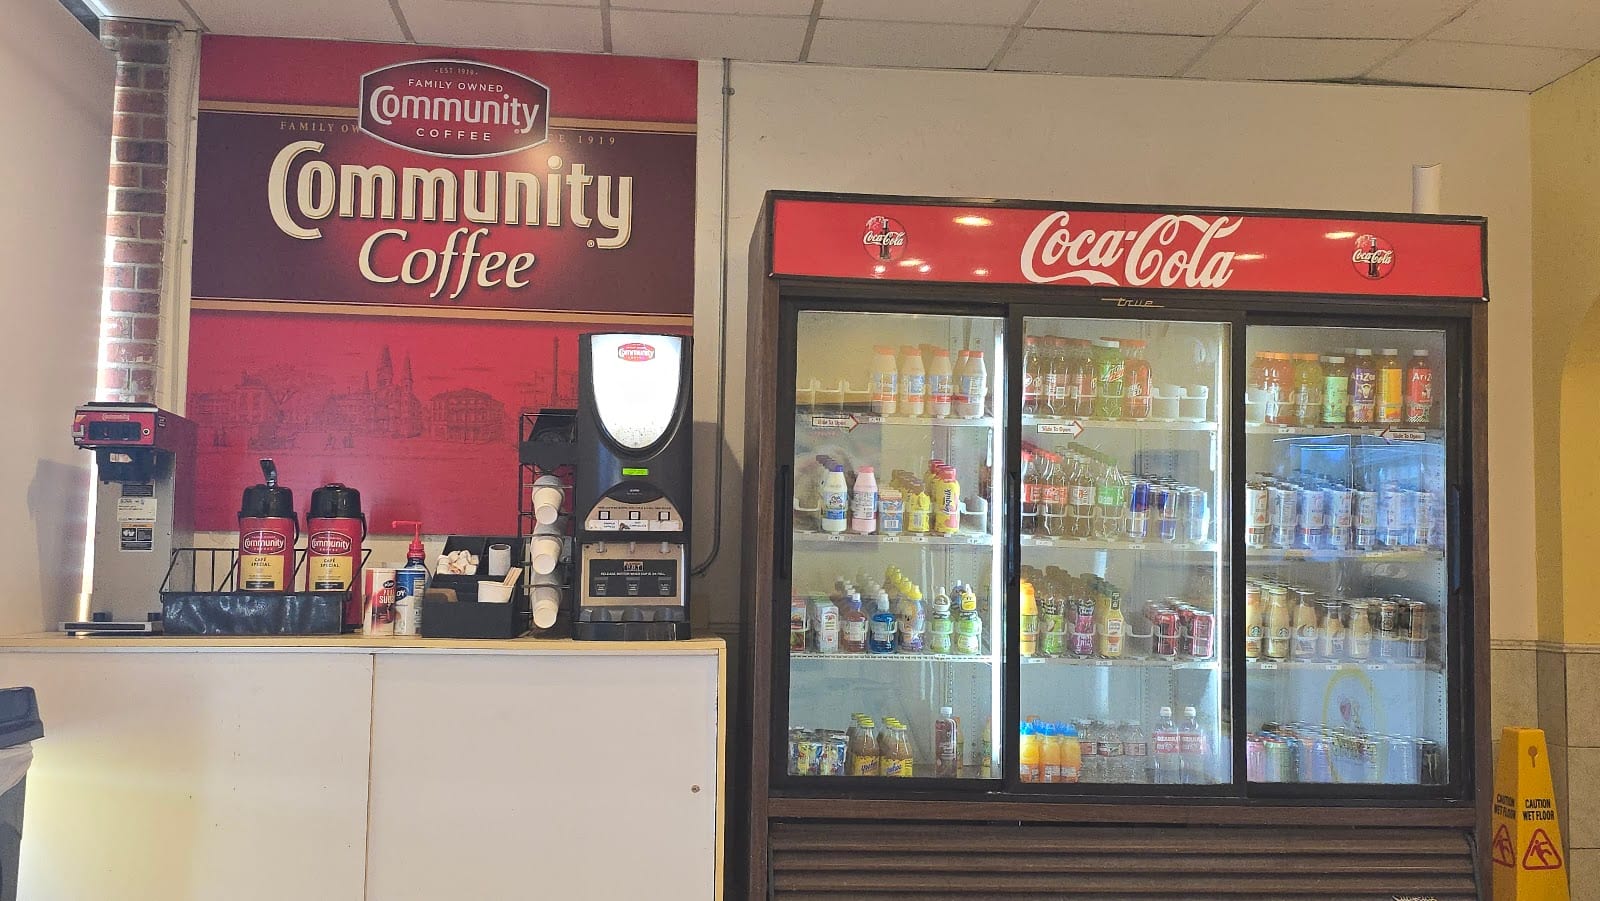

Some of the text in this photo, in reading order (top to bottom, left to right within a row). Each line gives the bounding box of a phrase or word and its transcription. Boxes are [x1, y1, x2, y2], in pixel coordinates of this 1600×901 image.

[408, 79, 504, 93] FAMILY OWNED
[369, 85, 540, 133] Community
[280, 121, 335, 132] FAMILY
[578, 135, 615, 145] 1919
[416, 128, 491, 141] COFFEE
[267, 140, 633, 248] Community
[863, 231, 905, 246] Coca-Cola
[1020, 210, 1244, 288] Coca-Cola
[1352, 249, 1393, 264] Coca-Cola
[358, 228, 536, 299] Coffee
[1525, 798, 1551, 809] CAUTION
[1522, 810, 1555, 821] WET FLOOR
